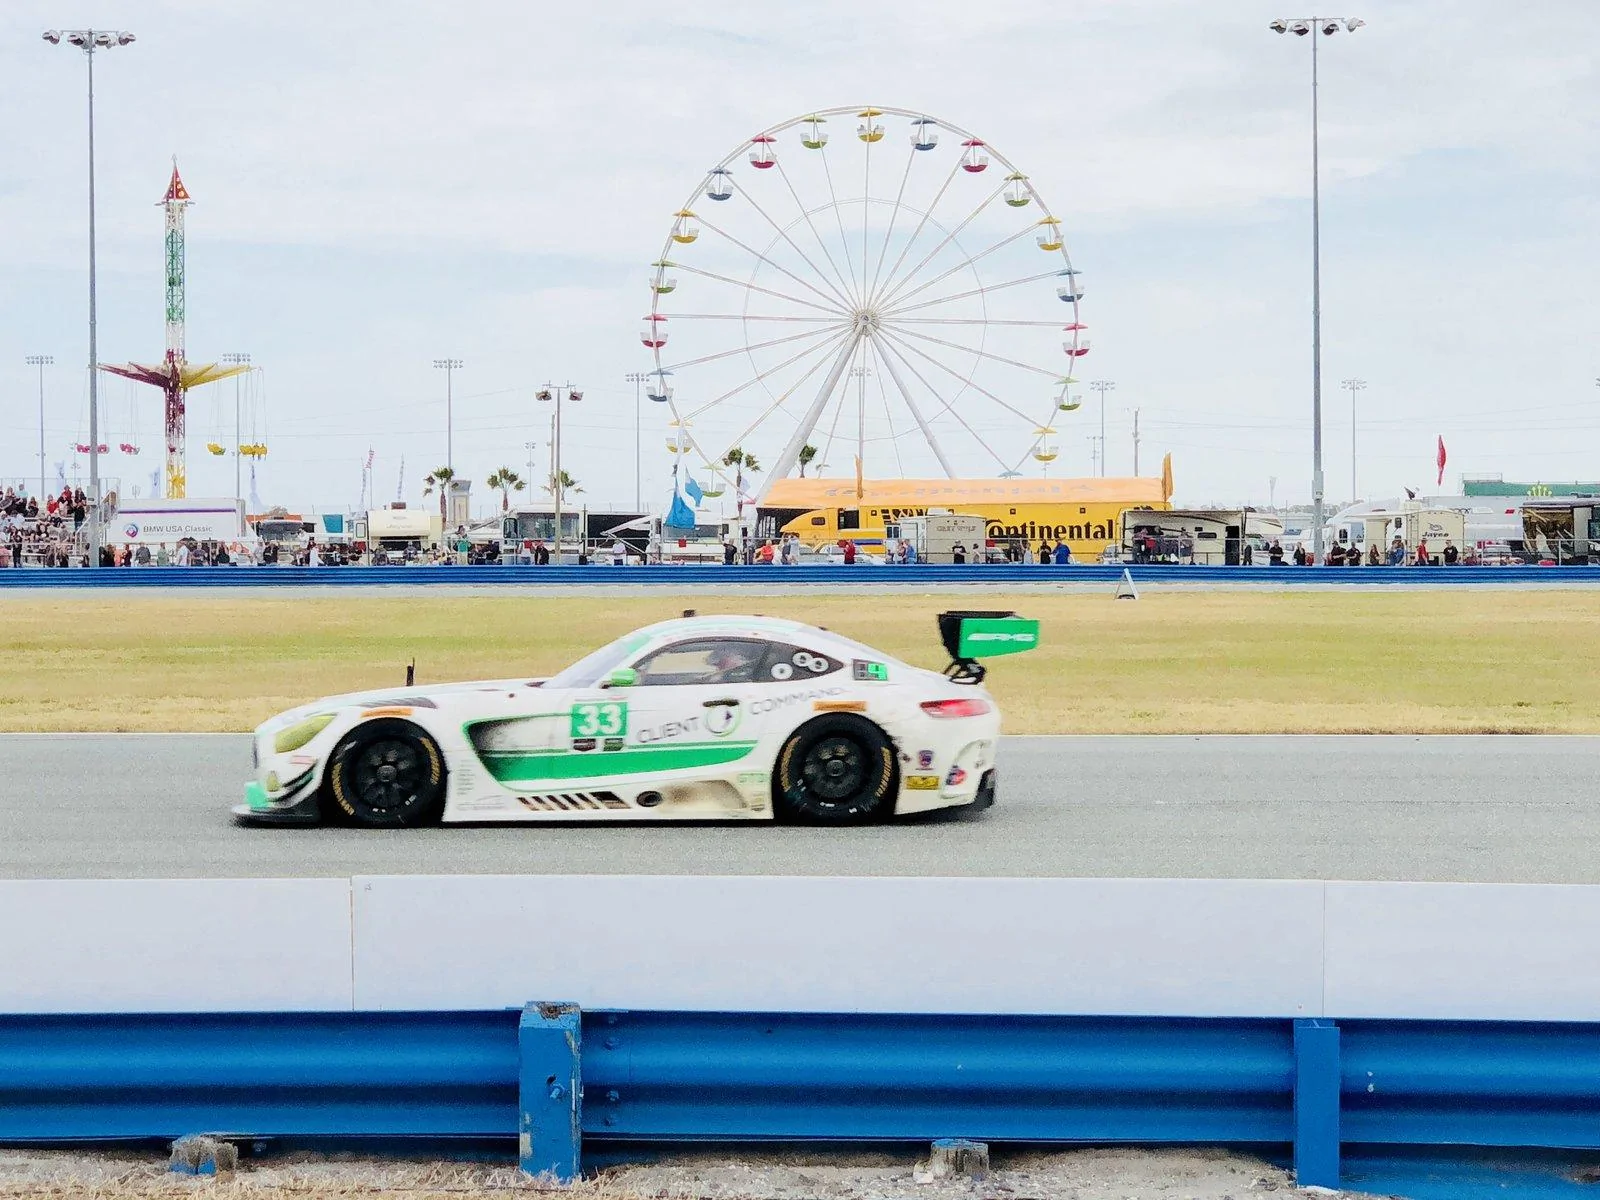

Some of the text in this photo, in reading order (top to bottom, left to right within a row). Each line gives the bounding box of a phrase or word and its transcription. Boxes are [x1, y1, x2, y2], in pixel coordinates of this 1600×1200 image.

[143, 525, 213, 534] BMW USA Classic
[576, 705, 622, 735] 33
[637, 690, 844, 743] CLIENT COMMAND
